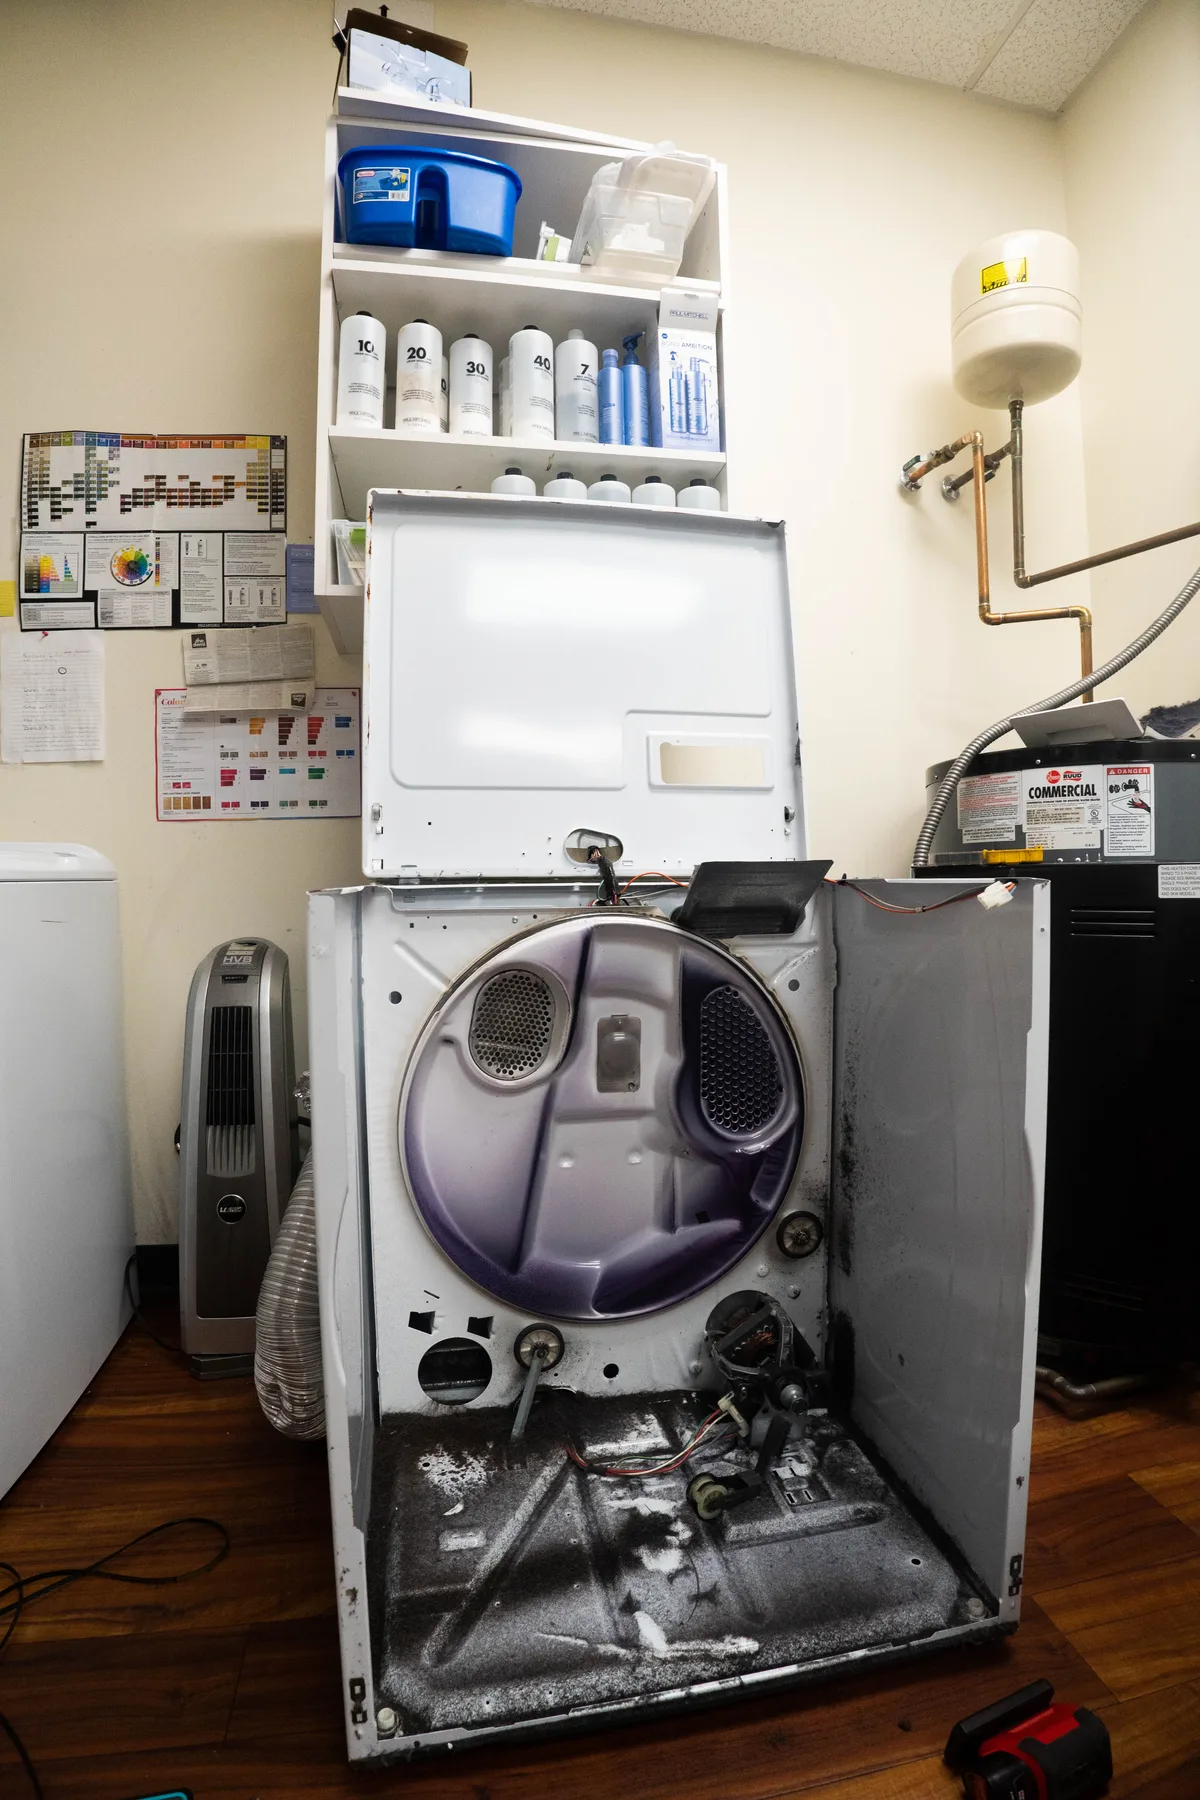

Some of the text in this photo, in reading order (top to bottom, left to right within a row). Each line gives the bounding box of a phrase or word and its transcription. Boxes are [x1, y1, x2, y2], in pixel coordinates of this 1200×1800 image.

[358, 340, 374, 353] 10
[681, 342, 713, 350] AMBITION
[406, 347, 426, 360] 20
[466, 362, 486, 376] 30
[534, 355, 551, 370] 40
[580, 364, 590, 375] 7
[441, 378, 446, 392] 0
[1028, 784, 1097, 799] COMMERCIAL
